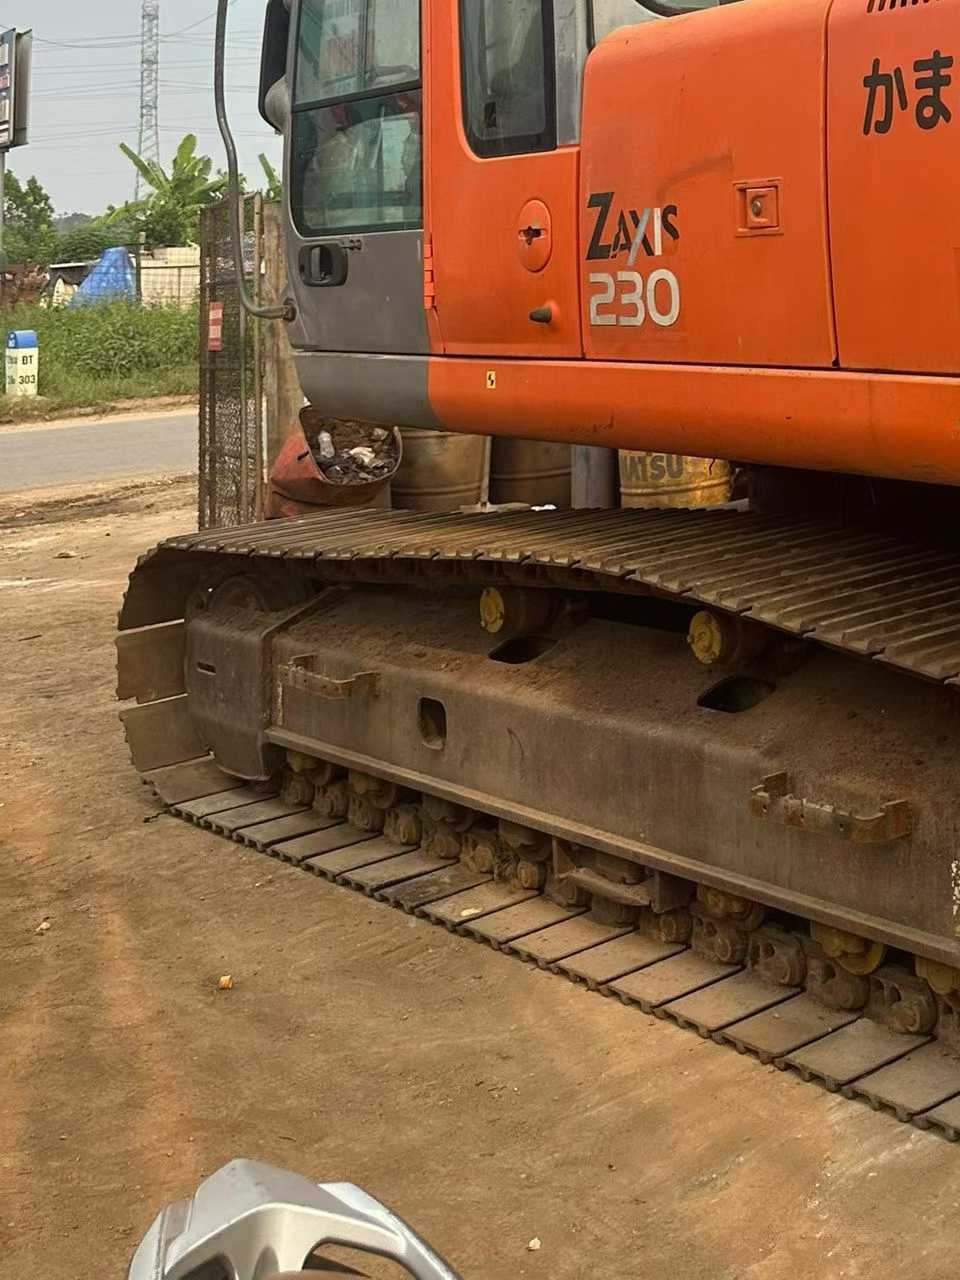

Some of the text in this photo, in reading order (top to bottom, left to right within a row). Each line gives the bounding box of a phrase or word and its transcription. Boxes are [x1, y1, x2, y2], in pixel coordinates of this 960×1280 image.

[586, 191, 680, 266] ZAXIS
[589, 269, 680, 326] 230
[18, 374, 36, 385] 303
